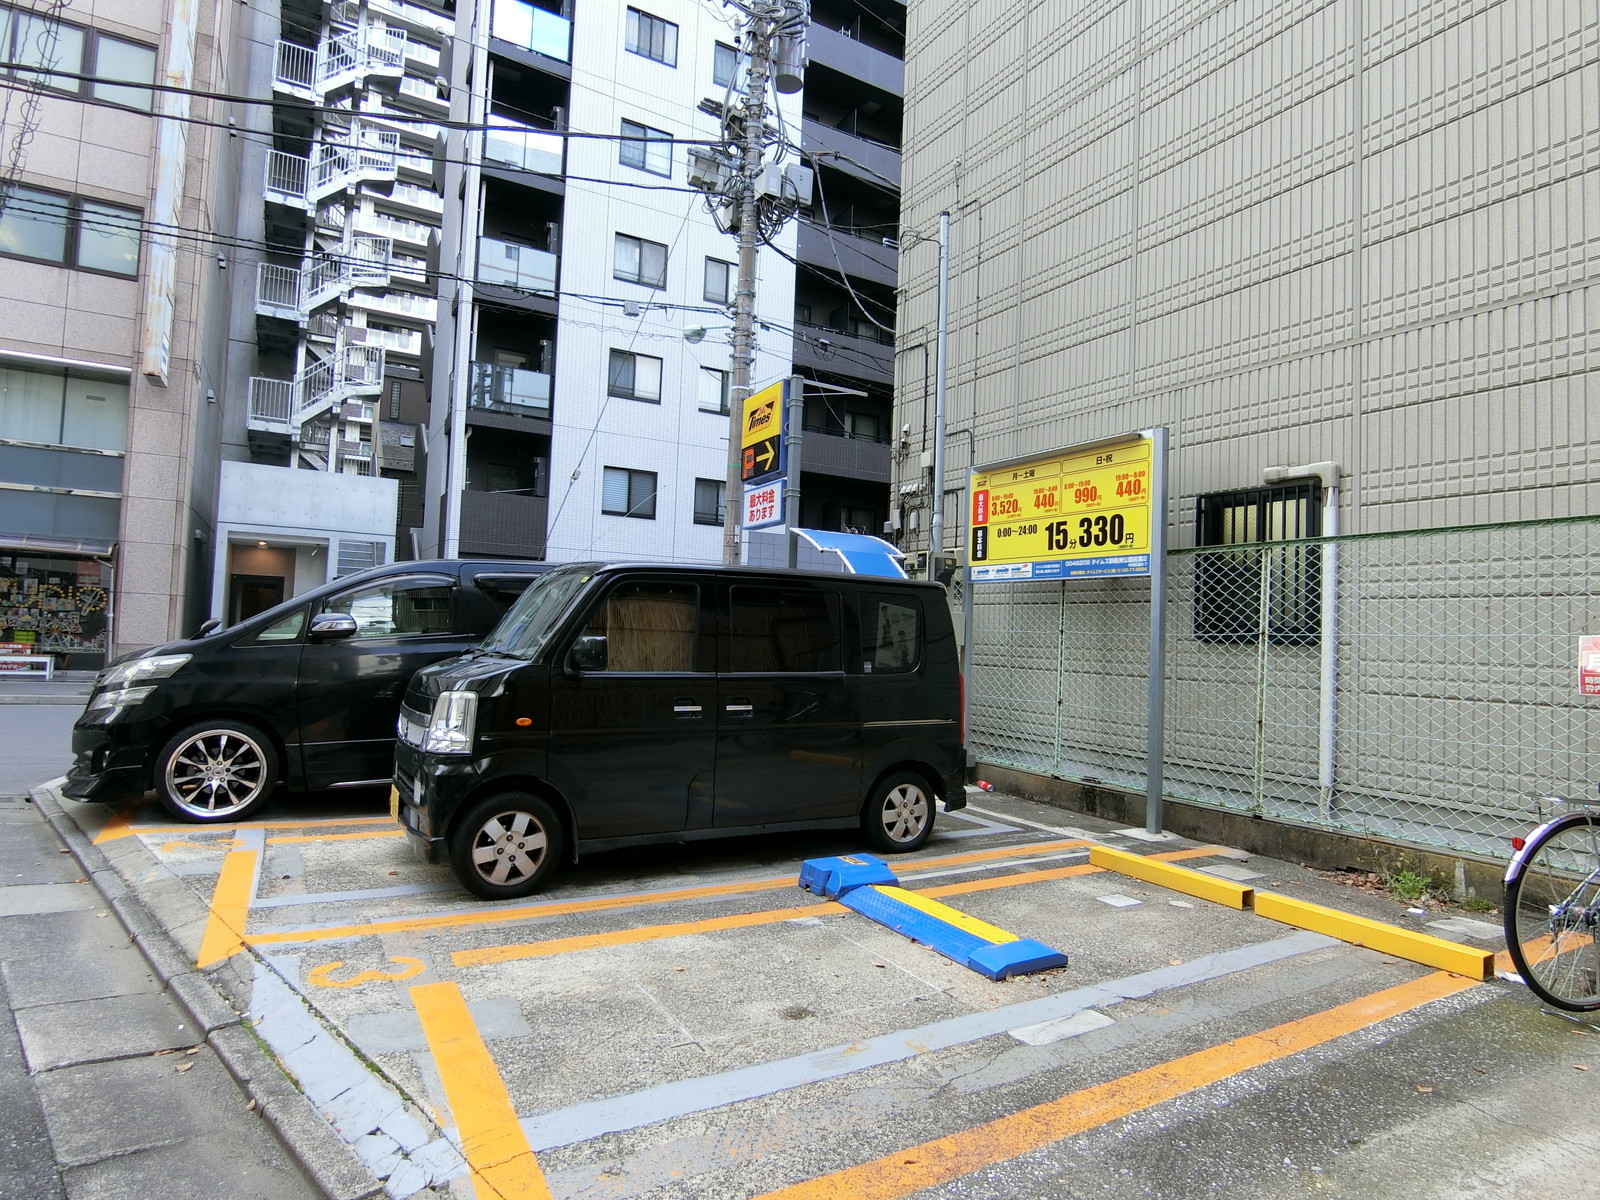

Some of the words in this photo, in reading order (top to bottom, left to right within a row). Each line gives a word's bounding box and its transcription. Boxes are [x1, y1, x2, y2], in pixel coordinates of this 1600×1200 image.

[748, 412, 771, 432] Times
[749, 489, 775, 509] 最大料金
[749, 505, 775, 522] あります
[307, 955, 427, 988] 3
